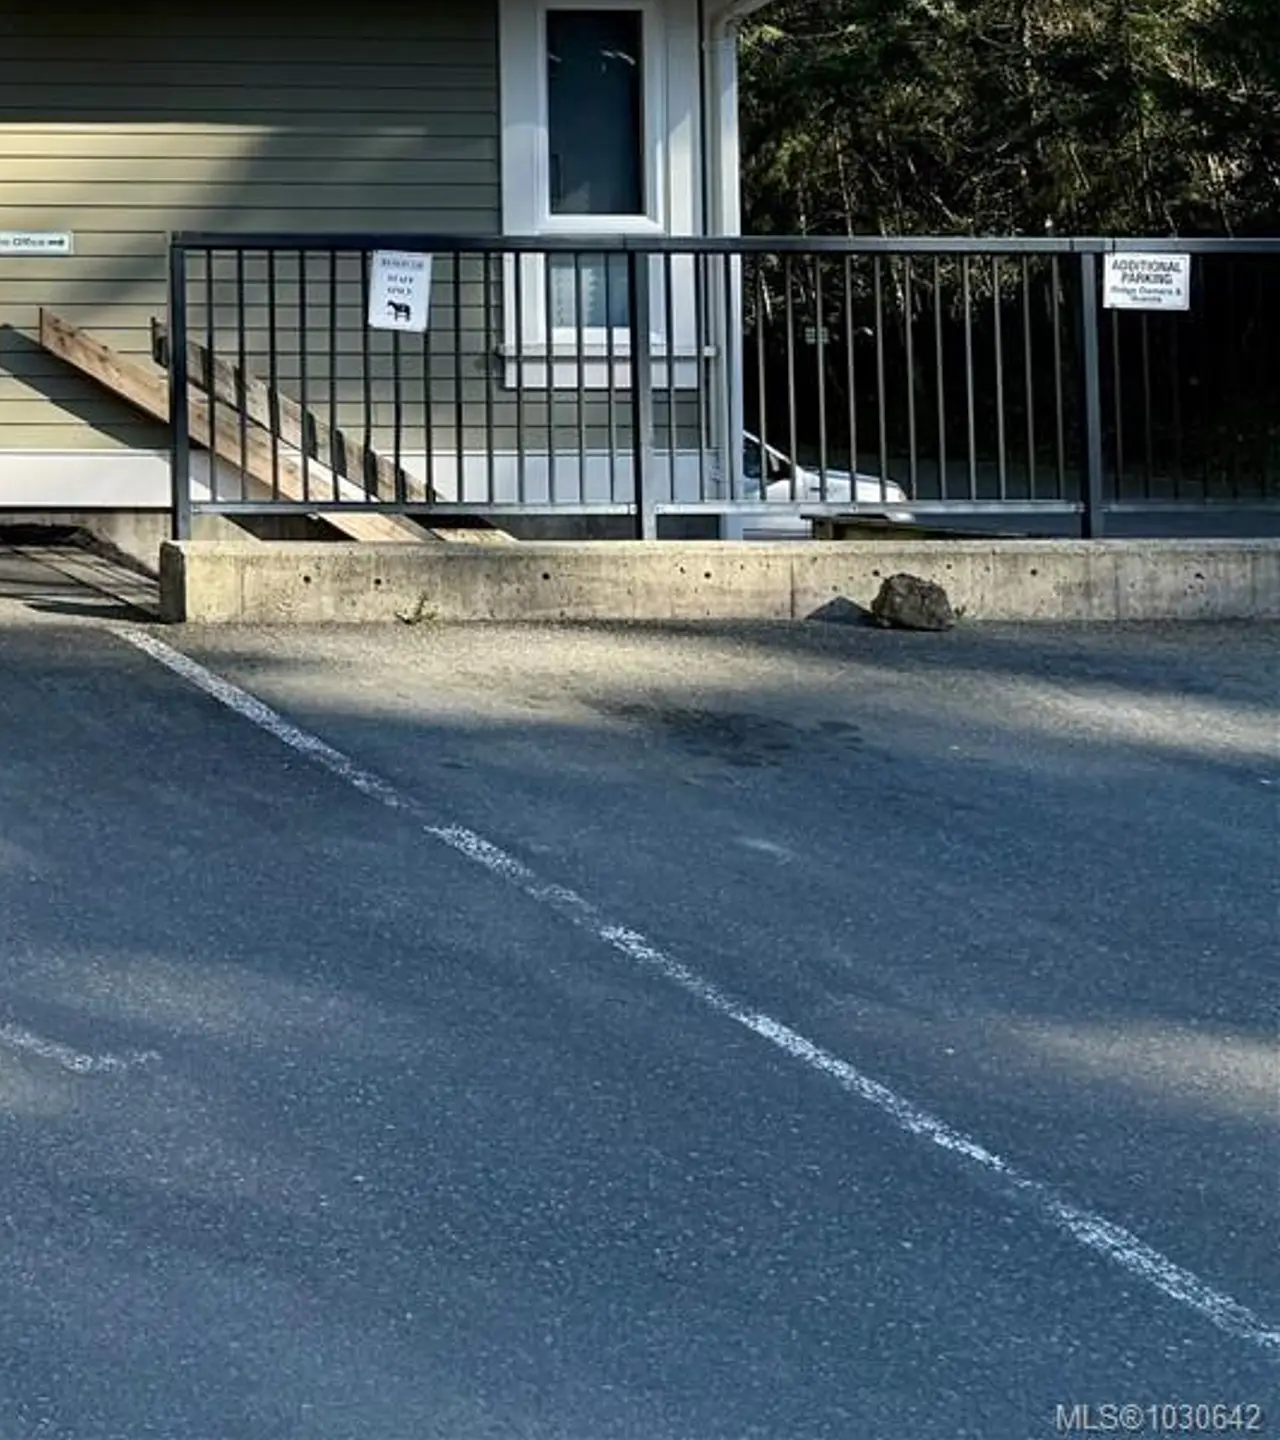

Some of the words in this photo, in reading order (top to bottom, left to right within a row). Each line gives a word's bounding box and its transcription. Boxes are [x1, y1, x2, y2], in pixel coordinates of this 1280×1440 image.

[13, 237, 45, 247] Office
[1111, 259, 1182, 273] ADDITIONAL
[1121, 272, 1174, 285] PARKING
